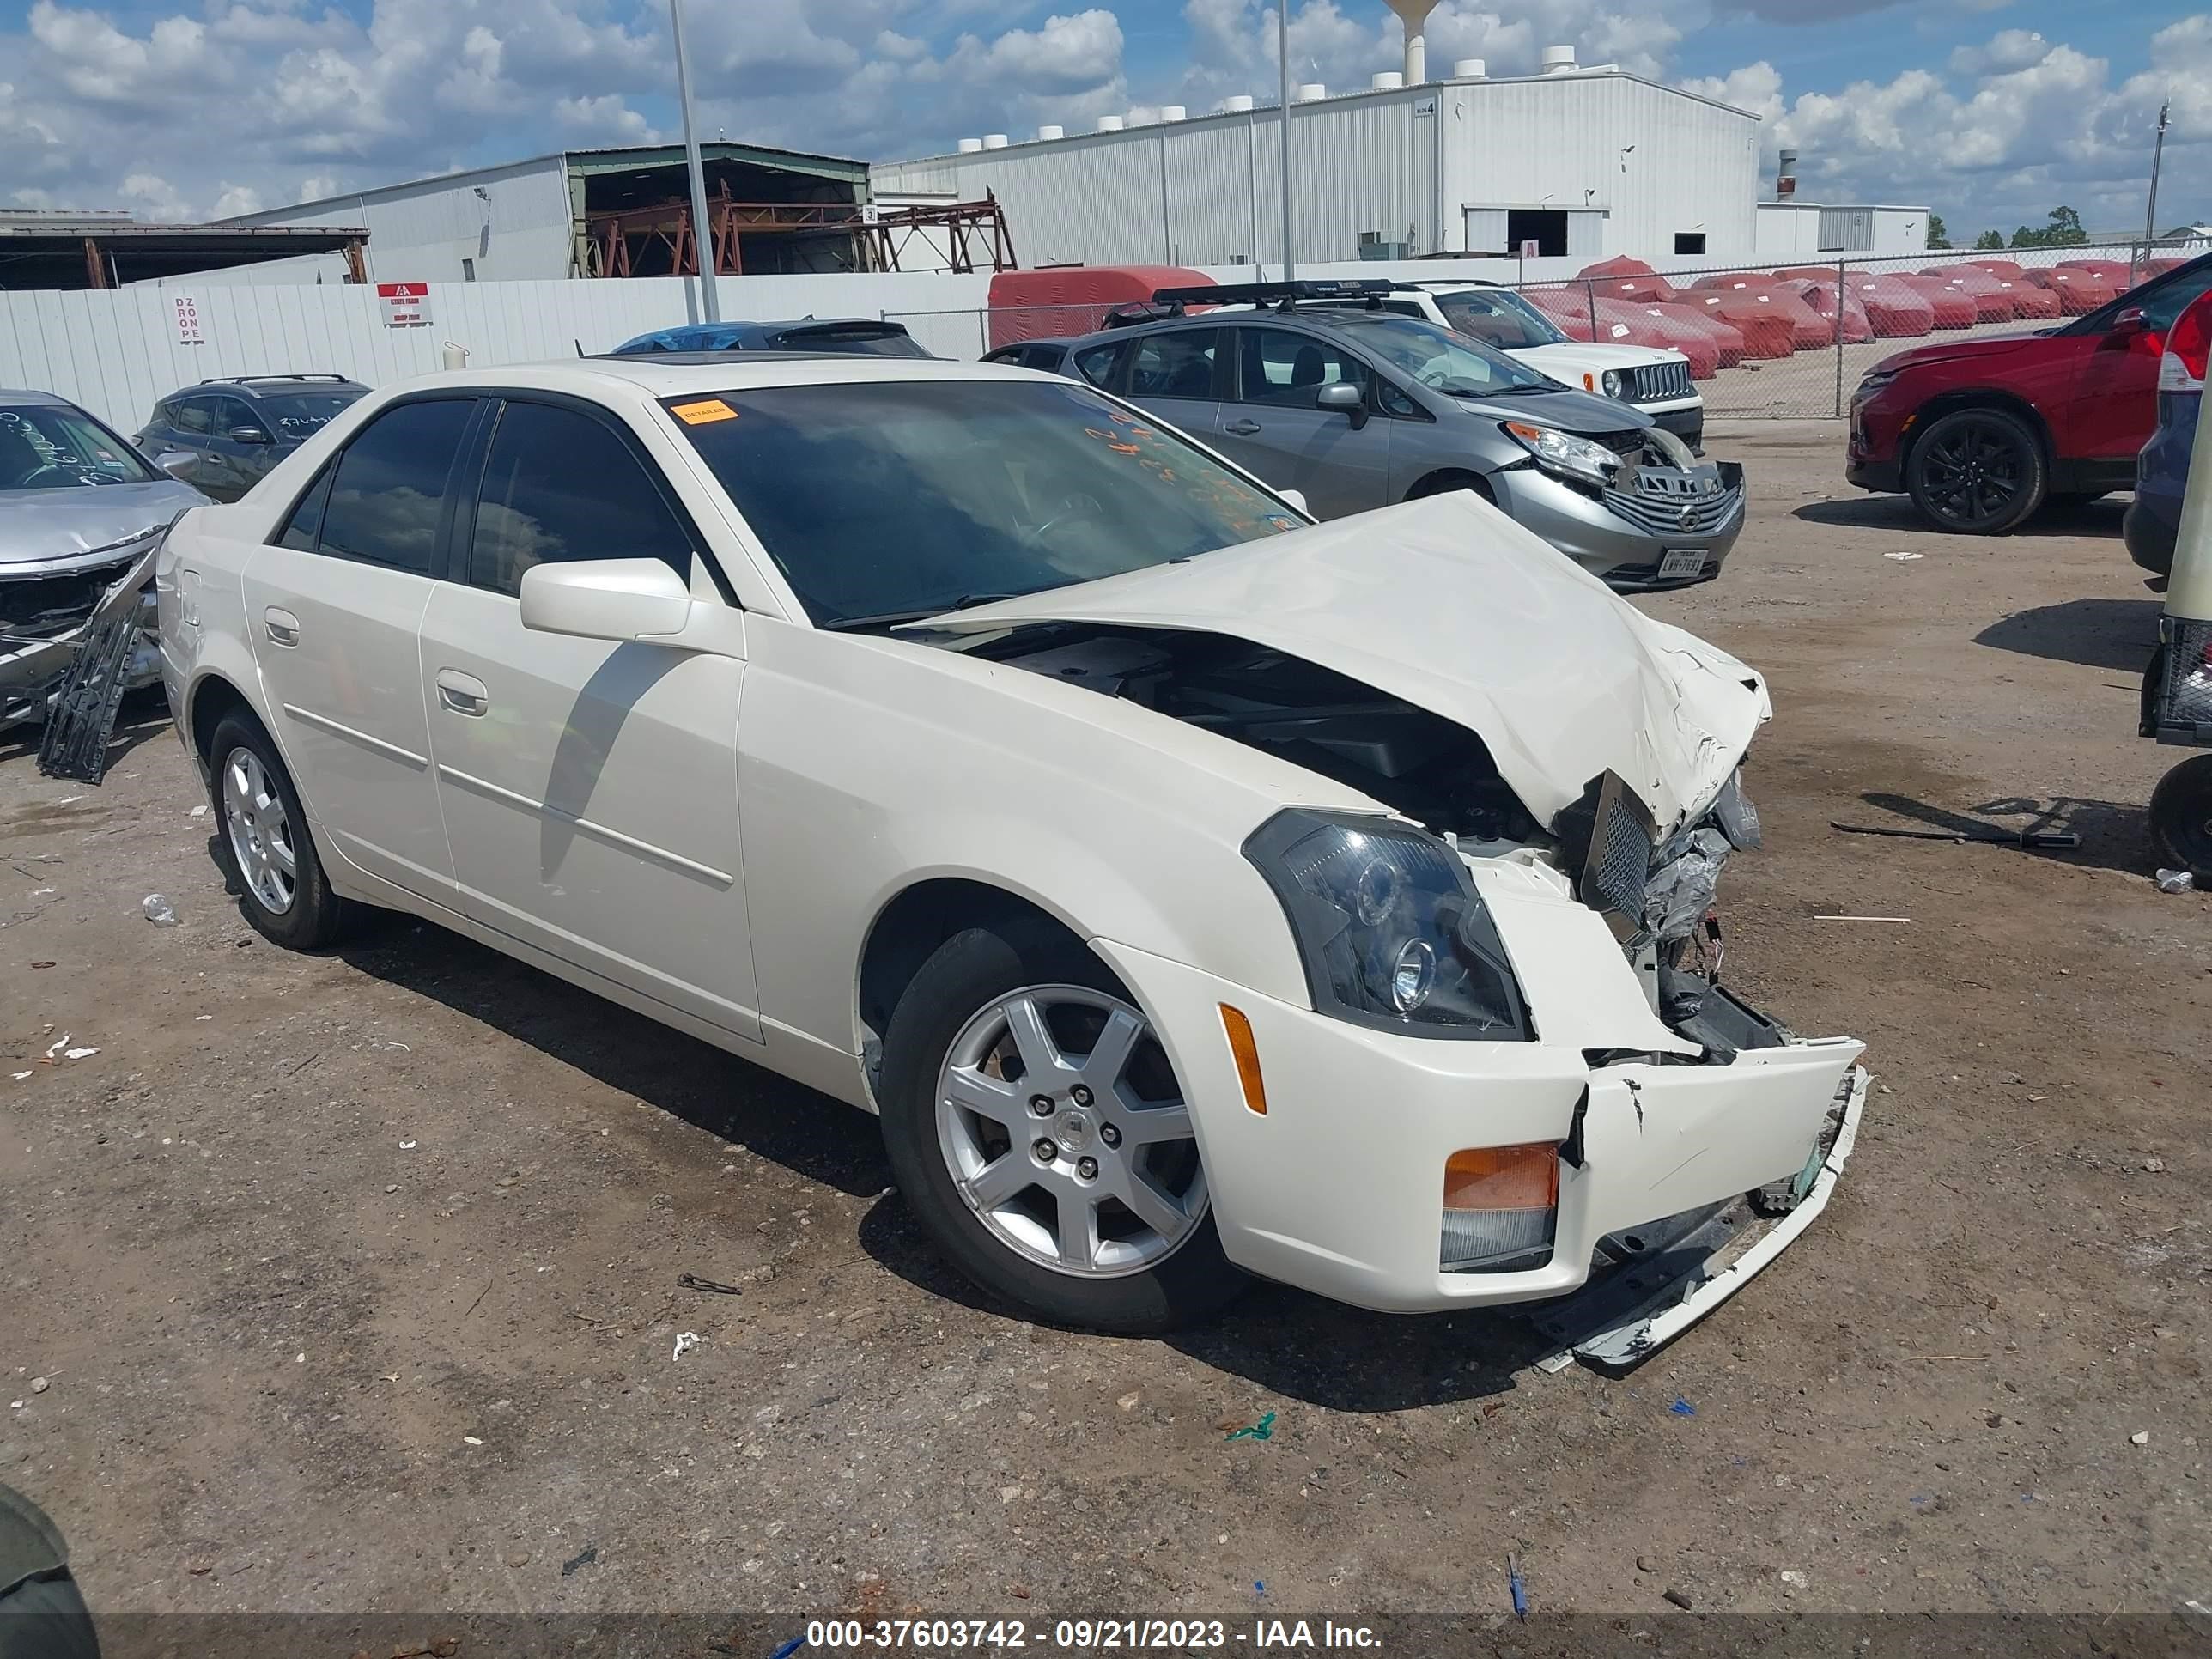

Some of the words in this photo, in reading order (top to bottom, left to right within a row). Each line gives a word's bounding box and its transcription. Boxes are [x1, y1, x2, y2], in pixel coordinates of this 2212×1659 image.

[1428, 102, 1434, 113] 4
[1526, 242, 1534, 257] A
[685, 408, 726, 418] DETAILED
